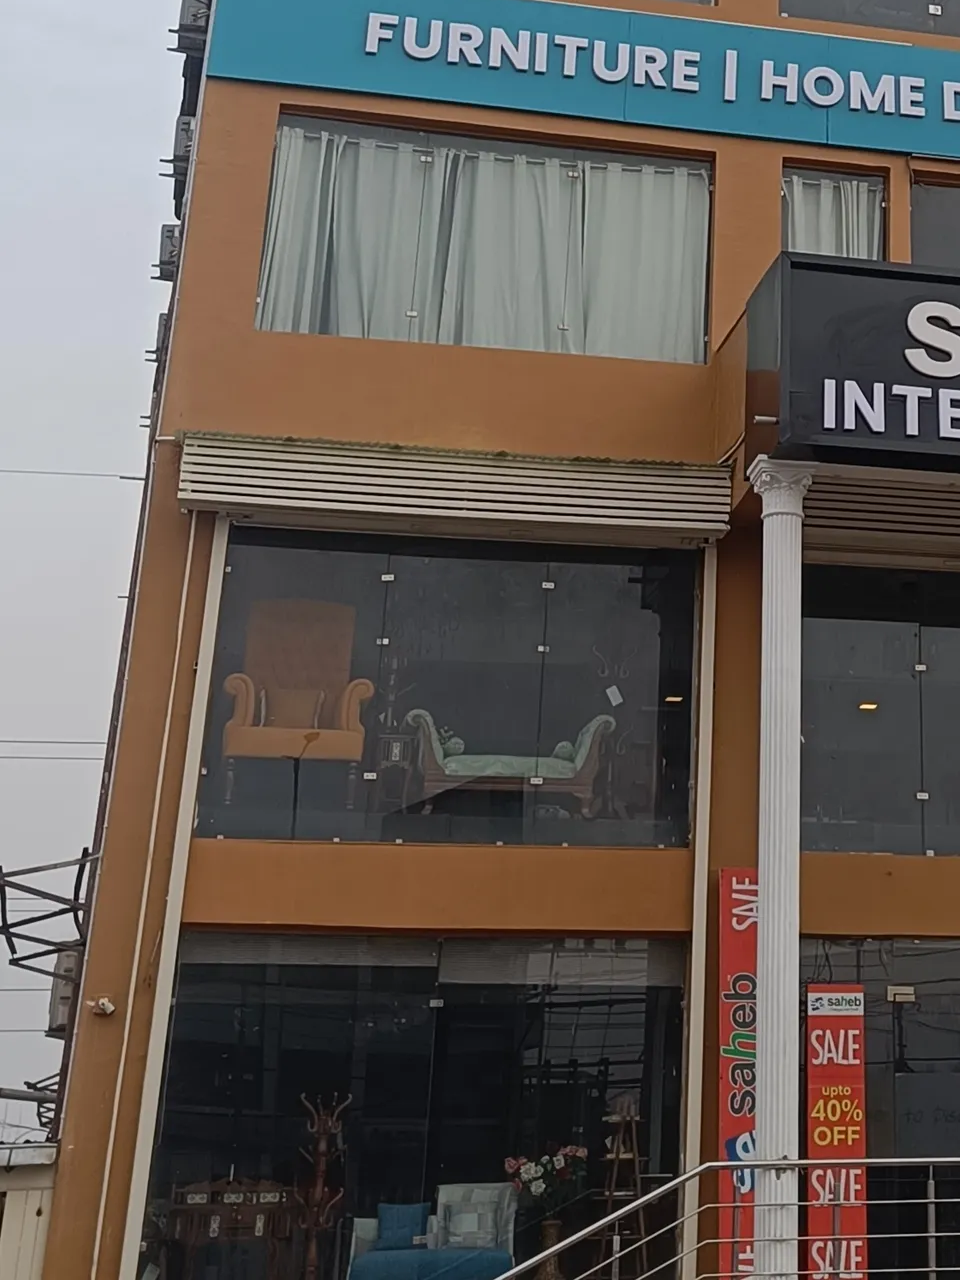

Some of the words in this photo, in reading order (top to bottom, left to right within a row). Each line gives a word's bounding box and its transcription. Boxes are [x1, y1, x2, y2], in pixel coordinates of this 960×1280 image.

[364, 12, 702, 93] FURNITURE
[760, 59, 927, 119] HOME
[827, 995, 862, 1007] saheb
[720, 972, 757, 1117] saheb
[810, 1029, 861, 1065] SALE
[822, 1085, 851, 1098] upto
[811, 1099, 863, 1122] 40%
[813, 1126, 861, 1146] OFF
[811, 1169, 862, 1207] SALE
[811, 1241, 863, 1279] SALE
